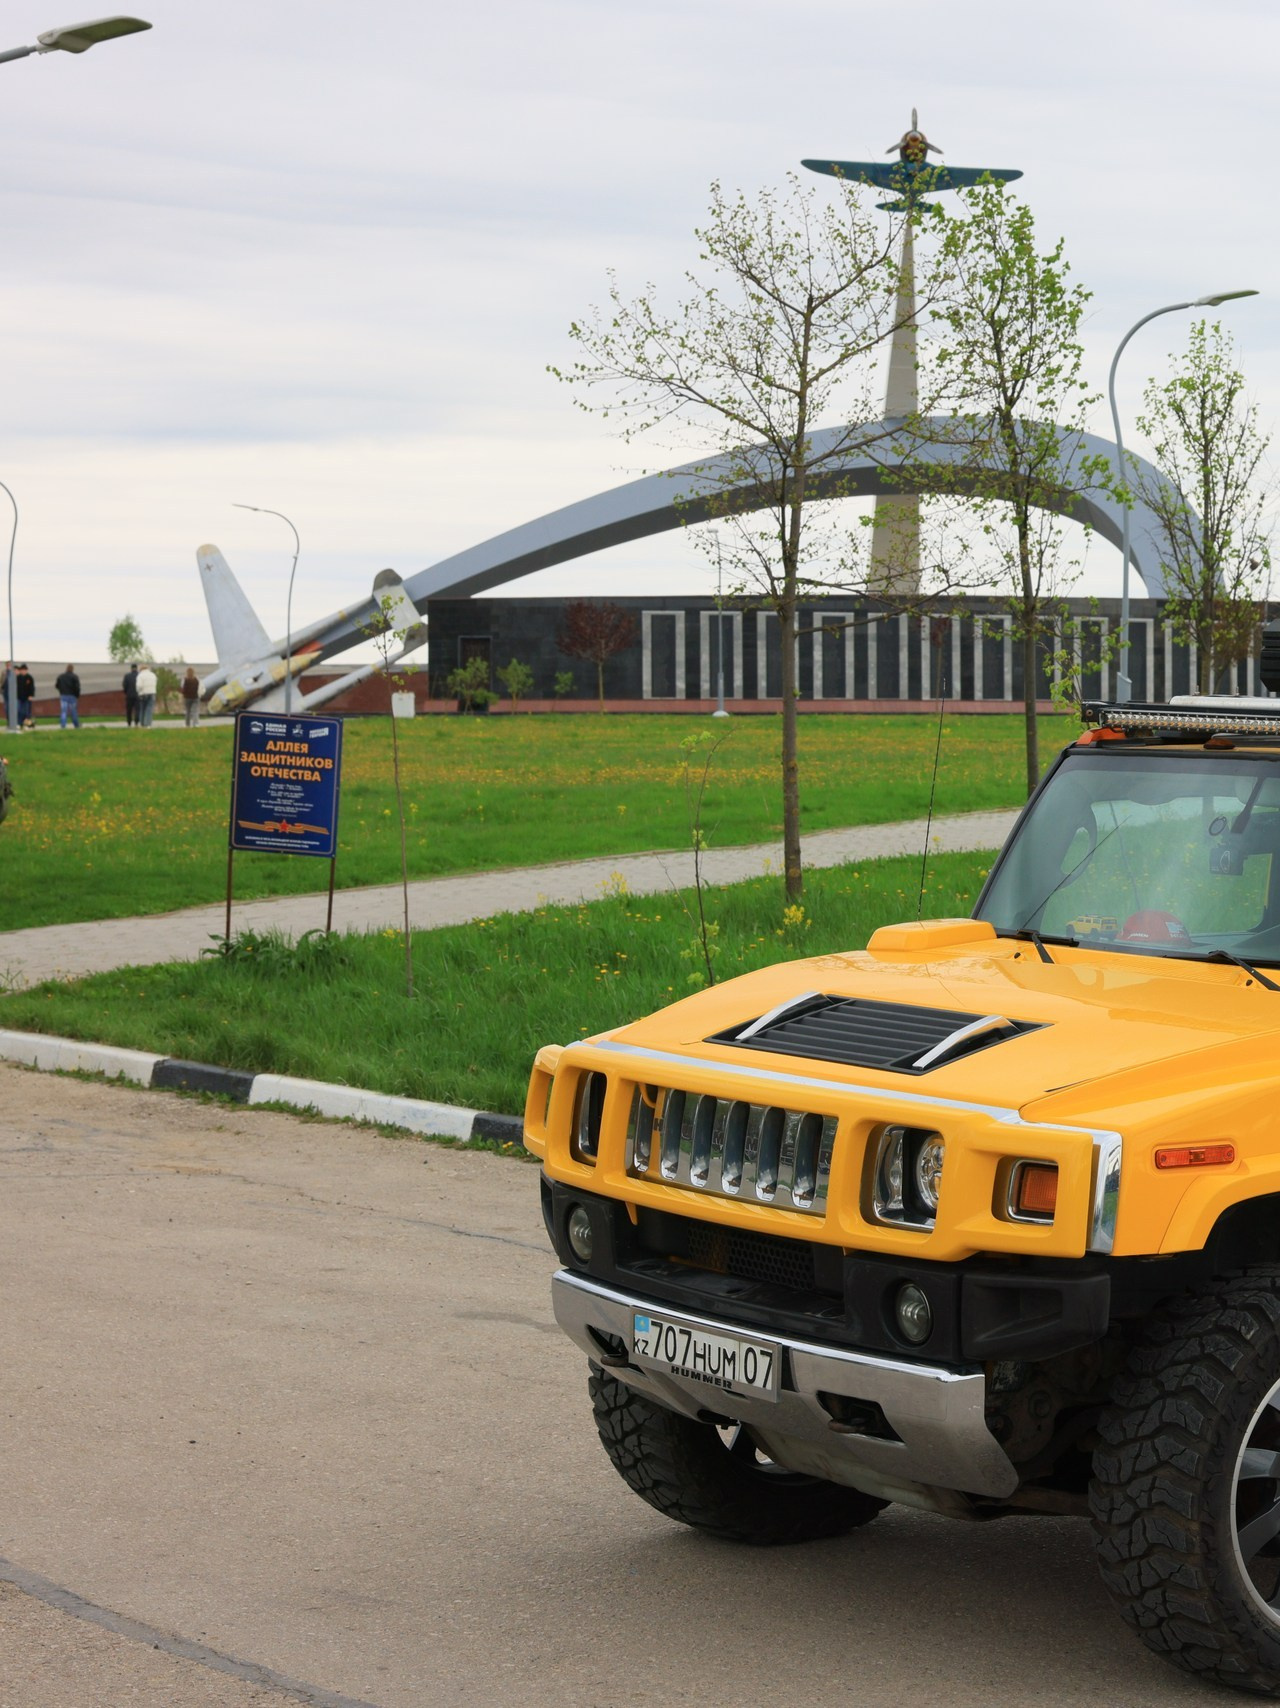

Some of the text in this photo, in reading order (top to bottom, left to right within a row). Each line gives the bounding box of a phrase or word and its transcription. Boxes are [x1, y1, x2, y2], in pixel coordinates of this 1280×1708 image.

[265, 740, 309, 754] АЛЛЕЯ
[240, 751, 333, 769] ЗАЩИТНИКОВ
[250, 766, 321, 782] ОТЕЧЕСТВА
[633, 1337, 649, 1355] KZ
[671, 1366, 732, 1389] HUMMER
